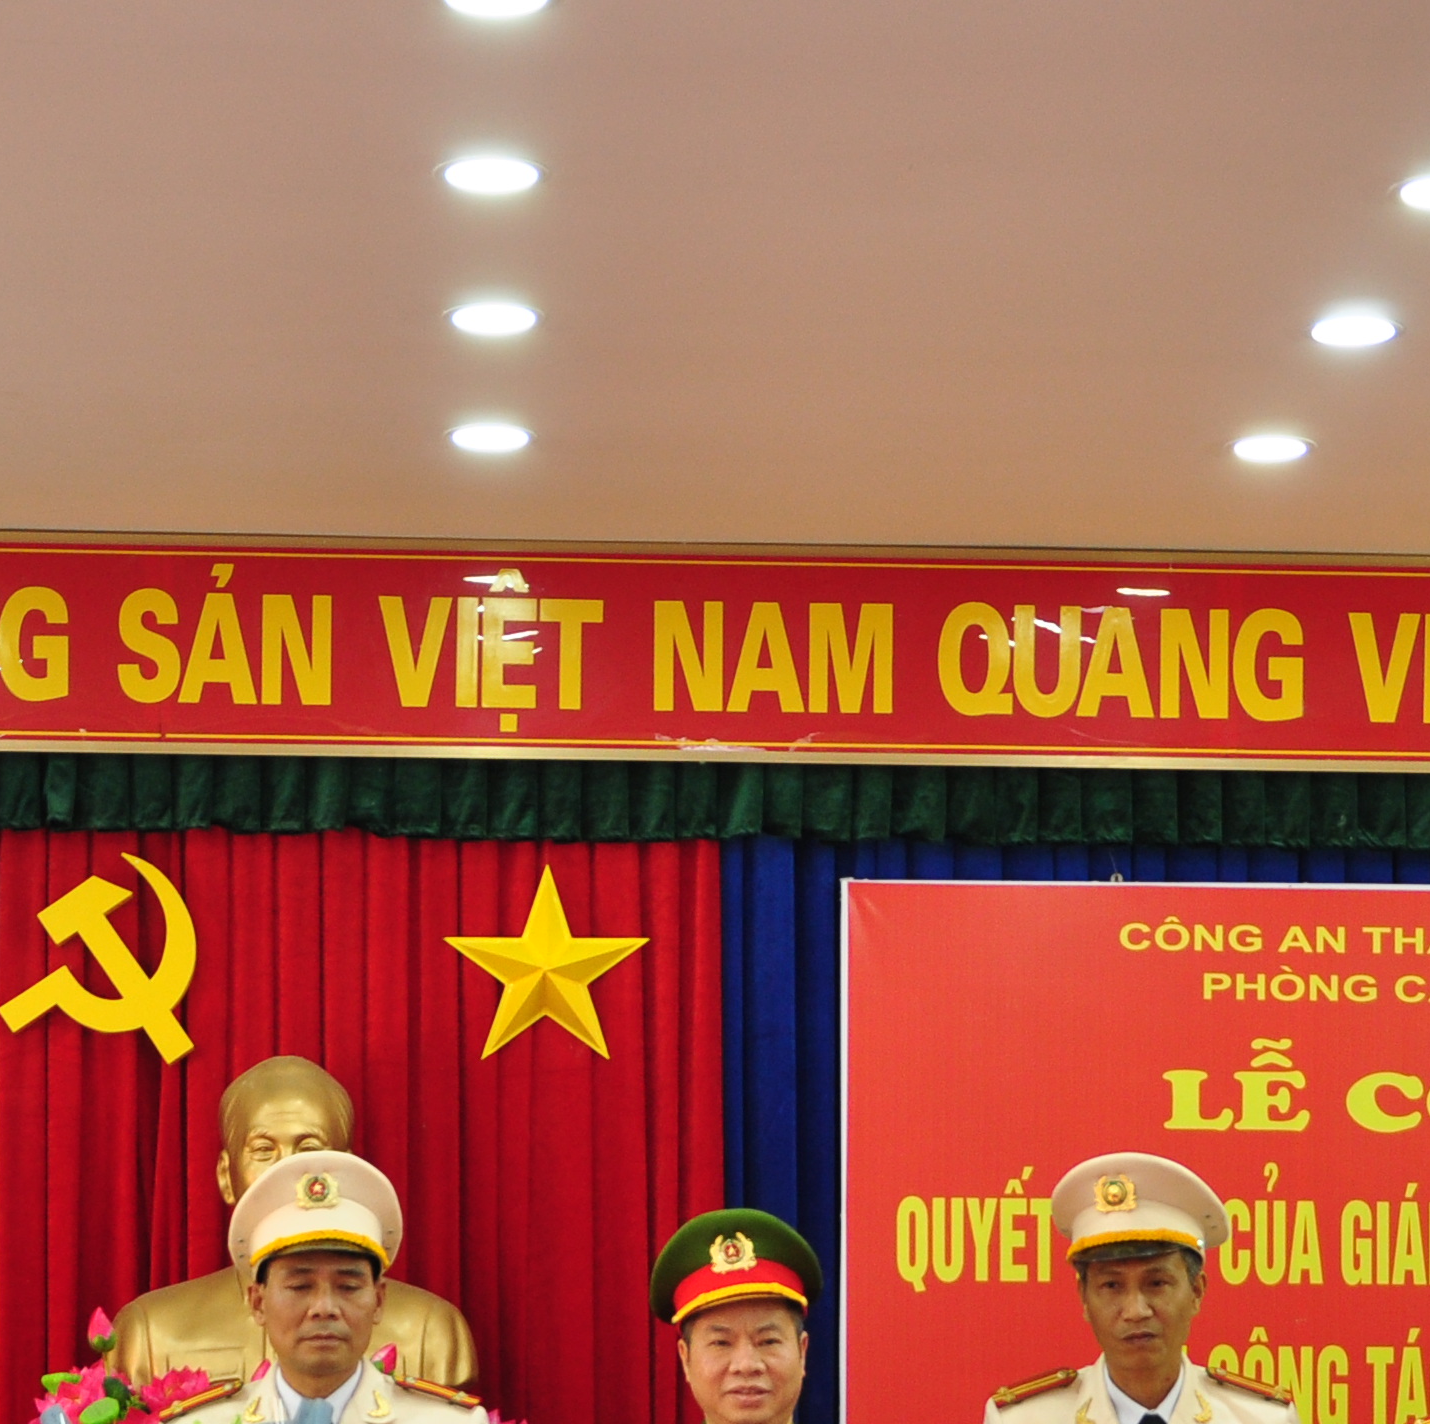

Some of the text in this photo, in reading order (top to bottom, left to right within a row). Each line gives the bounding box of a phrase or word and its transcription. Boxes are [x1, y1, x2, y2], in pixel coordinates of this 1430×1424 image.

[118, 563, 332, 706] SẢN
[379, 568, 604, 732] VIỆT
[654, 601, 894, 714] NAM
[938, 601, 1304, 722] QUANG
[1119, 916, 1263, 953] CÔNG
[1278, 926, 1346, 953] AN
[1203, 966, 1378, 1002] PHÒNG
[1163, 1038, 1311, 1132] LỄ
[896, 1165, 1053, 1293] QUYẾT
[1219, 1162, 1325, 1286] CỦA
